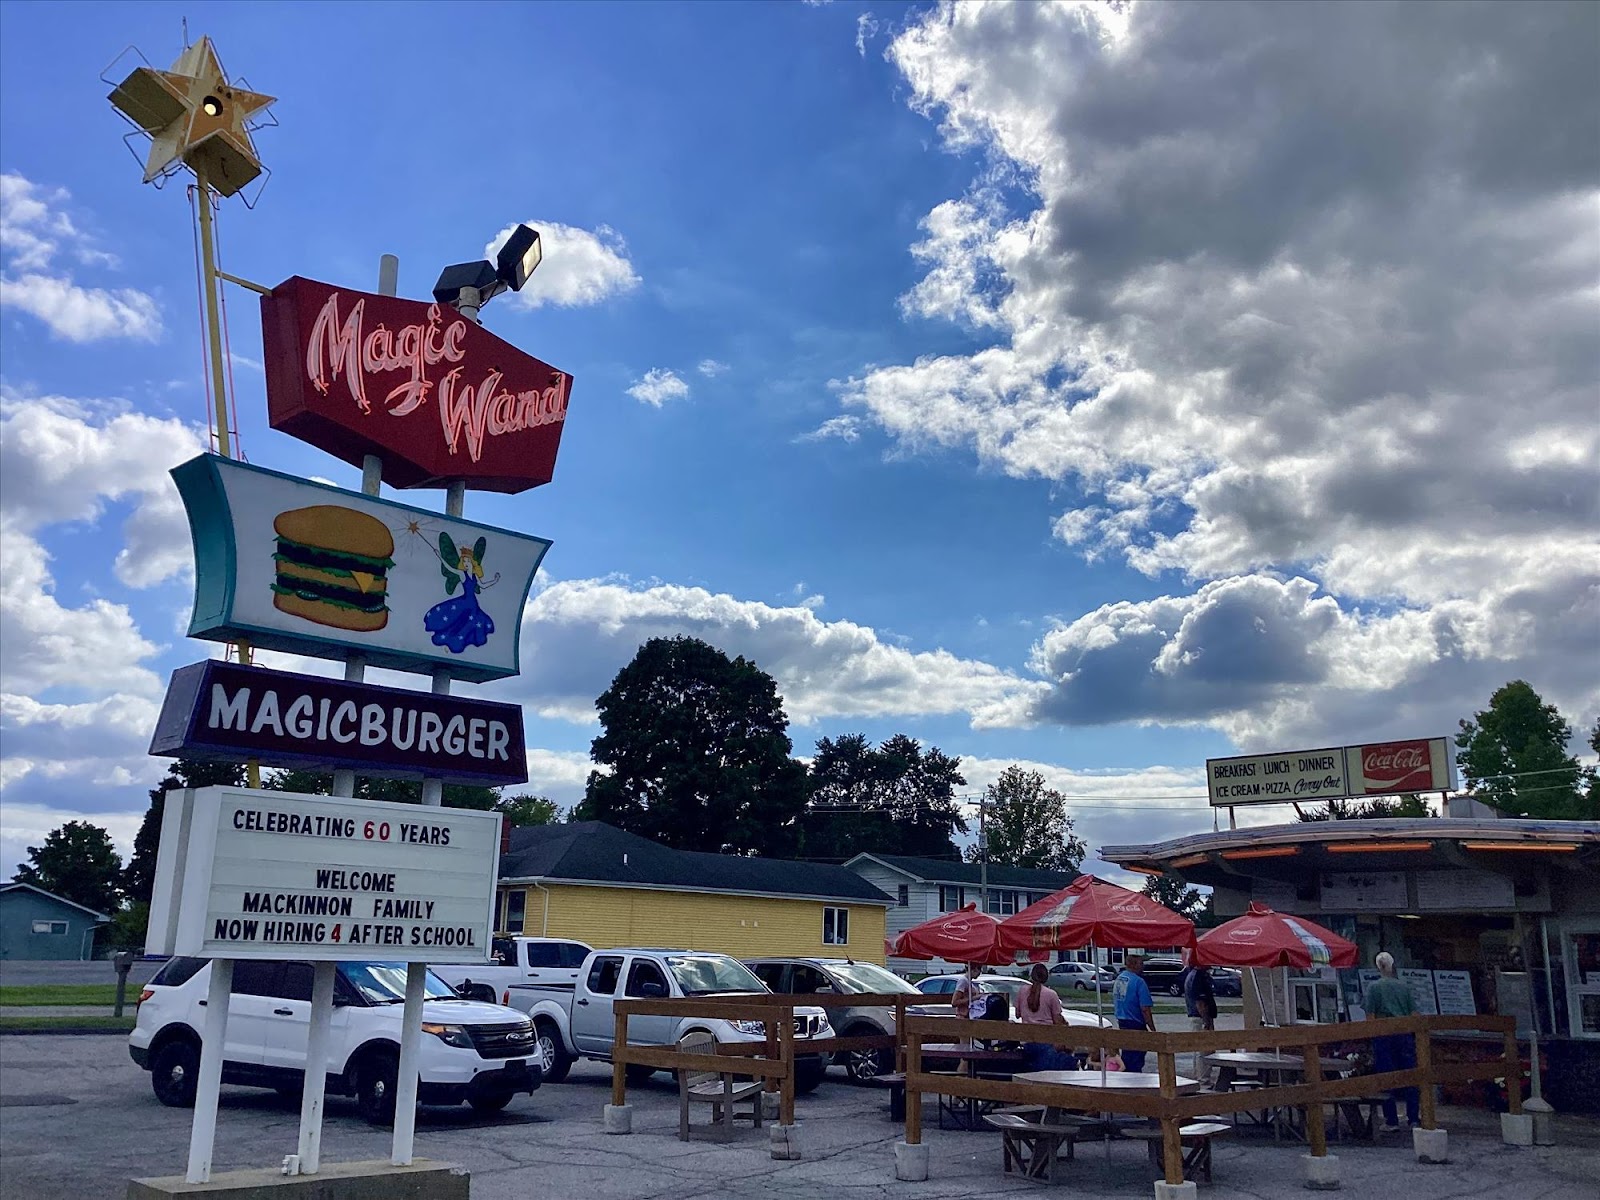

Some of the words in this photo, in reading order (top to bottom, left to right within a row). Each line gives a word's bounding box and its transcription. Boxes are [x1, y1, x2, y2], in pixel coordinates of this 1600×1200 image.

[306, 292, 467, 416] Magic
[439, 365, 568, 464] Wand
[207, 683, 510, 762] MAGICBURGER
[1213, 763, 1257, 780] BREAKFAST
[1263, 759, 1291, 775] LUNCH
[1298, 756, 1335, 773] DINNER
[1364, 747, 1424, 771] Coca-Cola
[1215, 785, 1229, 798] ICE
[1231, 780, 1261, 797] CREAM
[1265, 778, 1291, 794] PIZZA
[1293, 778, 1322, 796] Carry
[1322, 775, 1341, 790] Out
[233, 809, 356, 837] CELEBRATING
[363, 820, 391, 841] 60
[399, 823, 451, 846] YEARS
[316, 868, 396, 893] WELCOME
[242, 891, 352, 917] MACKINNON
[373, 899, 435, 920] FAMILY
[214, 918, 261, 941] NOW
[262, 922, 326, 943] HIRING
[330, 922, 341, 943] 4
[348, 925, 405, 946] AFTER
[410, 926, 476, 947] SCHOOL
